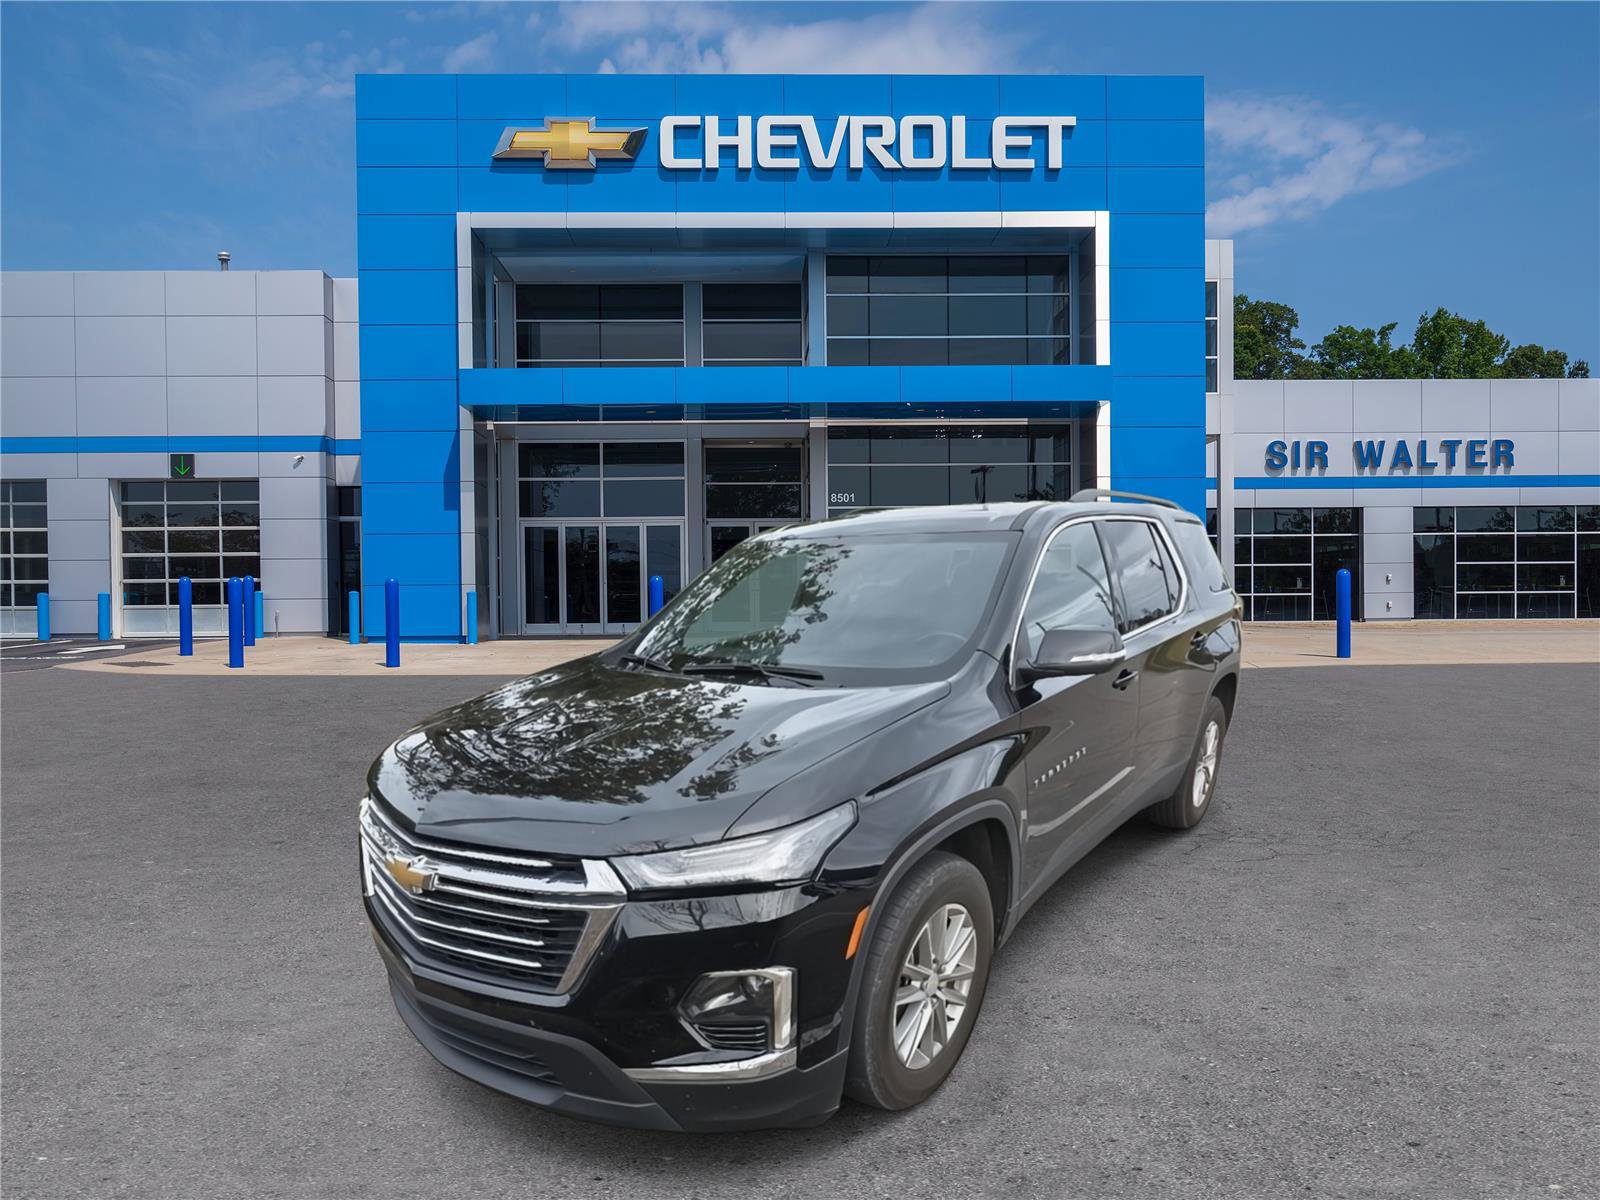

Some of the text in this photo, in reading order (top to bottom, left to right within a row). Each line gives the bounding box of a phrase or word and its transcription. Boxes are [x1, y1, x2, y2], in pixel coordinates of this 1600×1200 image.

[659, 115, 1077, 169] CHEVROLET
[1265, 439, 1515, 469] SIR WALTER
[830, 493, 855, 503] 8501
